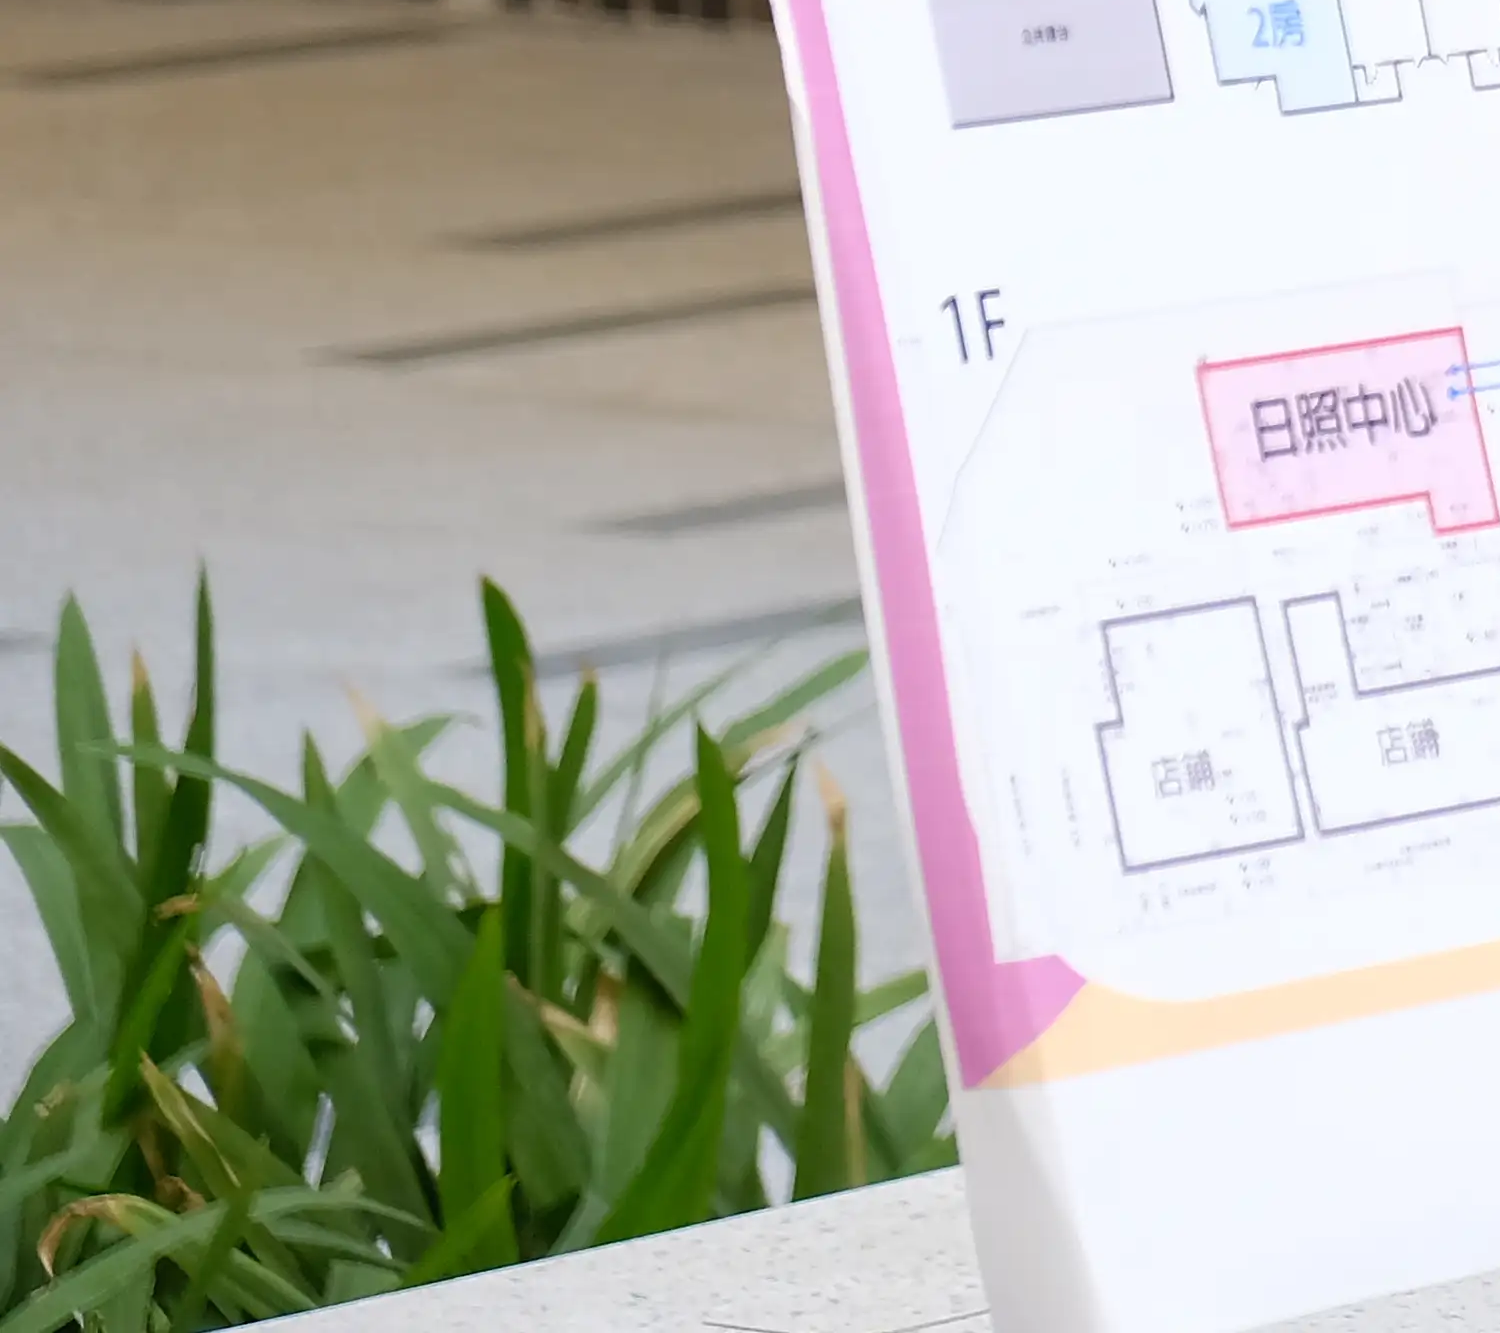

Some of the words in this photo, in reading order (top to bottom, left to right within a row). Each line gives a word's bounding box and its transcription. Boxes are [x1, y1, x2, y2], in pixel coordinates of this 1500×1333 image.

[1246, 0, 1305, 48] 2房
[940, 288, 1005, 363] 1F
[1251, 377, 1438, 462] 日照中心
